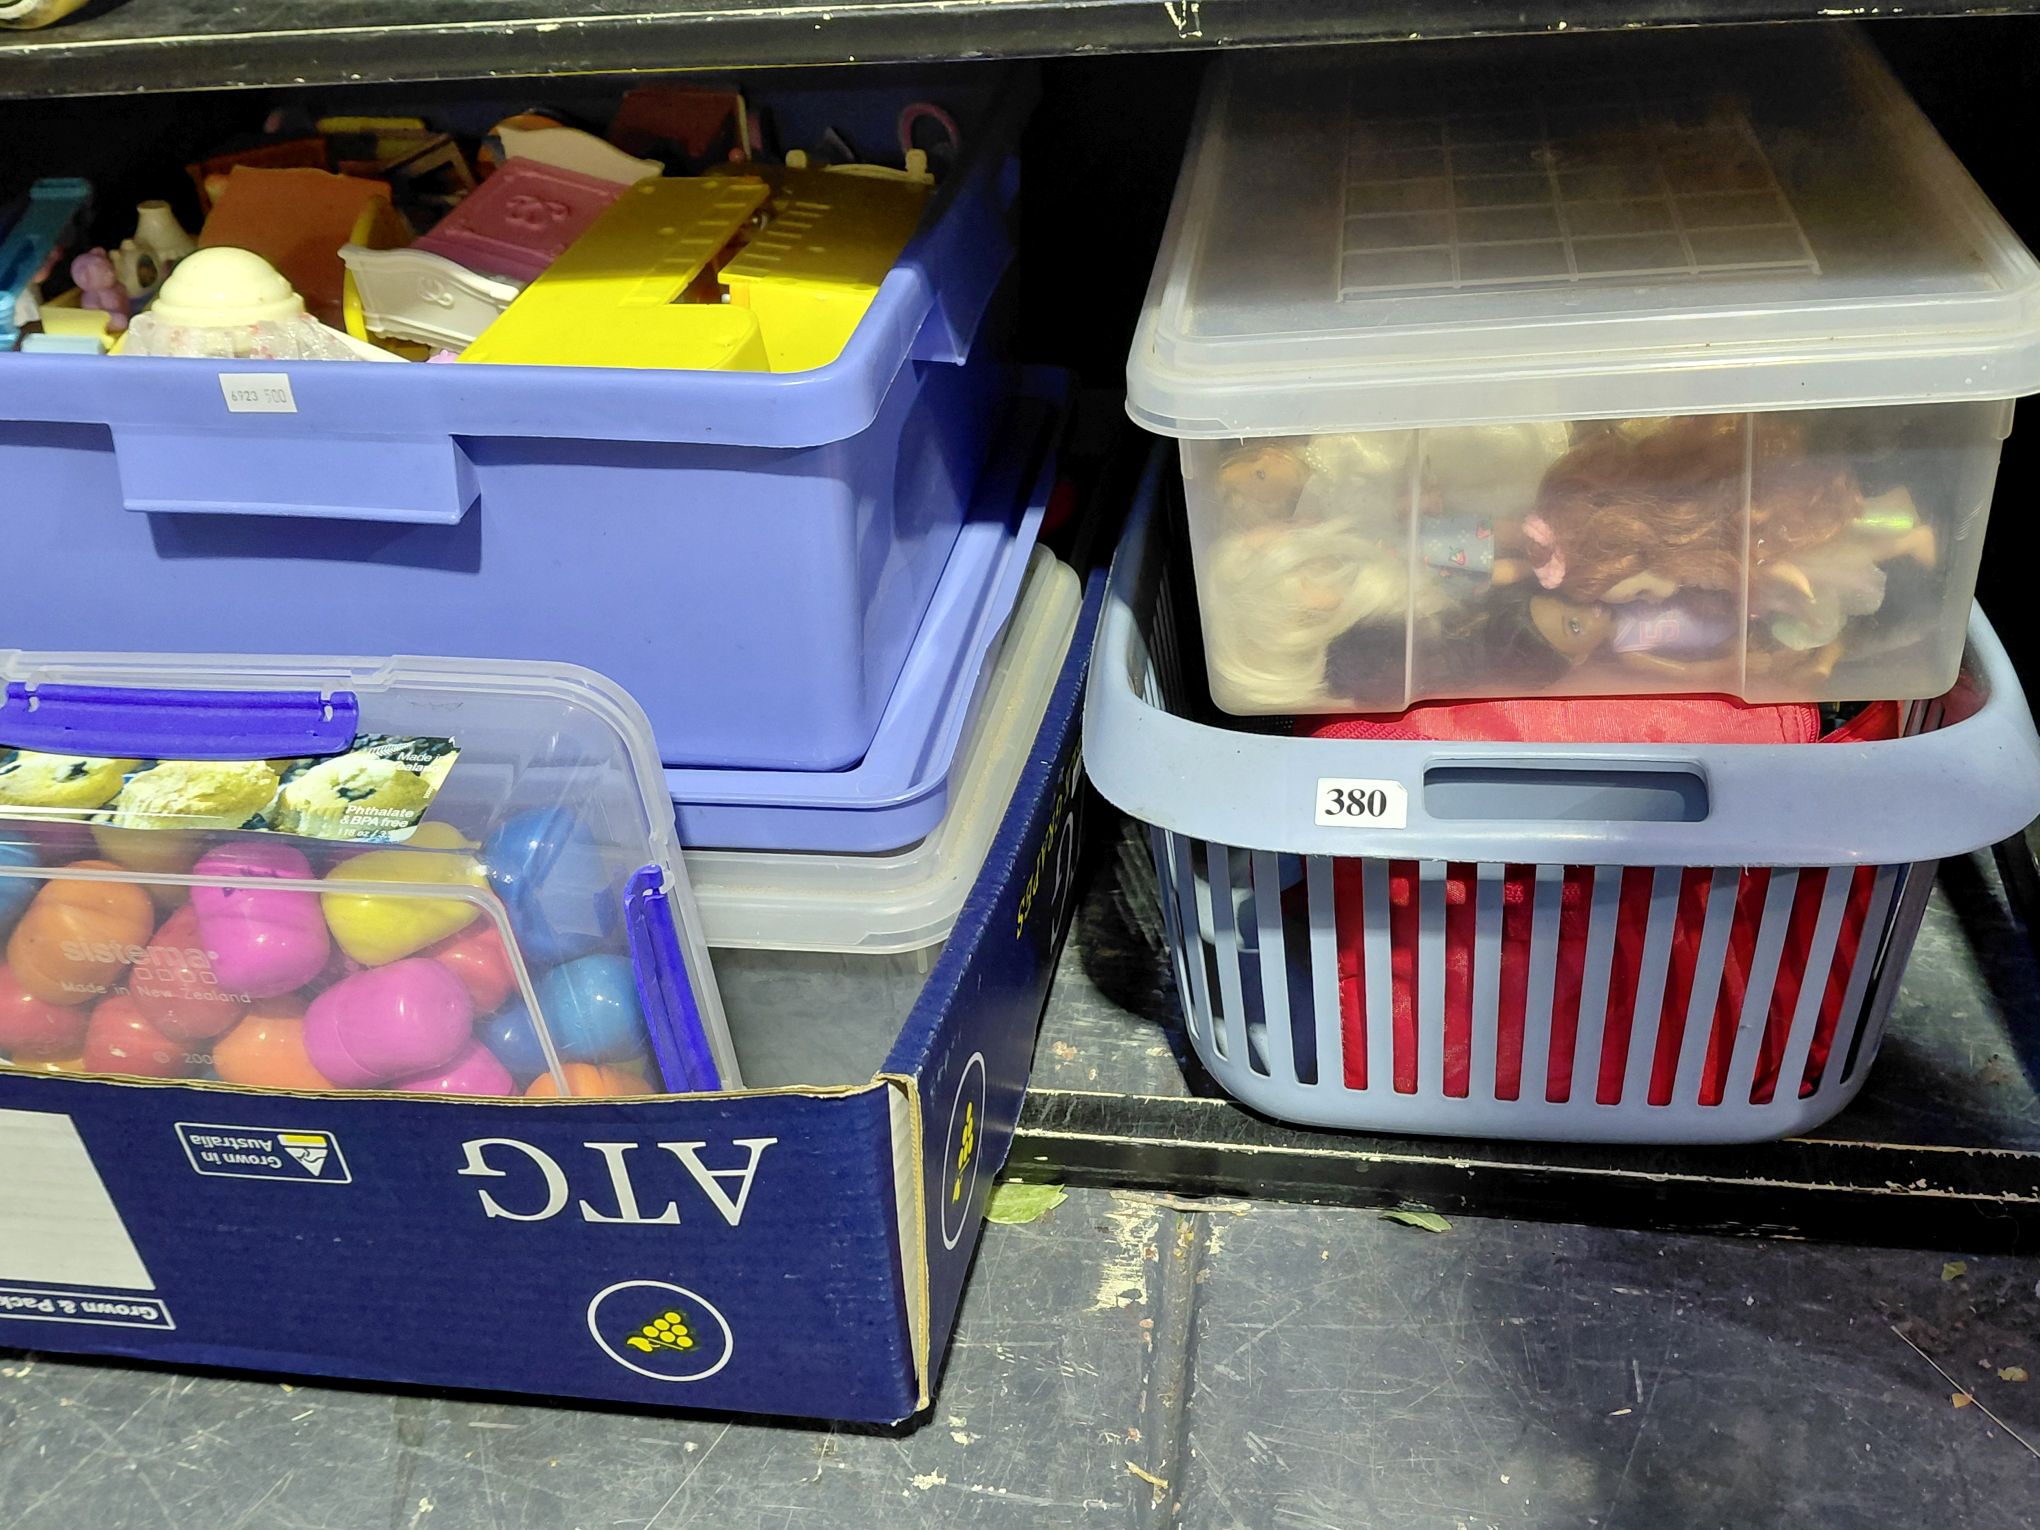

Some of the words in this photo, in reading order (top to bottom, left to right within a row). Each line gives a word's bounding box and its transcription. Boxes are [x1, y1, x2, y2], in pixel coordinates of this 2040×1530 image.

[396, 751, 433, 763] Made
[345, 805, 415, 818] Phthalate
[1324, 788, 1388, 818] 380
[350, 815, 379, 827] BPA
[380, 817, 409, 828] free
[62, 941, 211, 969] sistema
[62, 981, 108, 995] Made
[114, 984, 130, 997] in
[136, 984, 173, 1000] New
[179, 984, 251, 1004] Zealand
[189, 1134, 273, 1153] Australia
[201, 1151, 222, 1165] in
[222, 1152, 282, 1169] Grown
[457, 1137, 778, 1226] ATG
[57, 1300, 77, 1314] &
[80, 1301, 158, 1321] Grown
